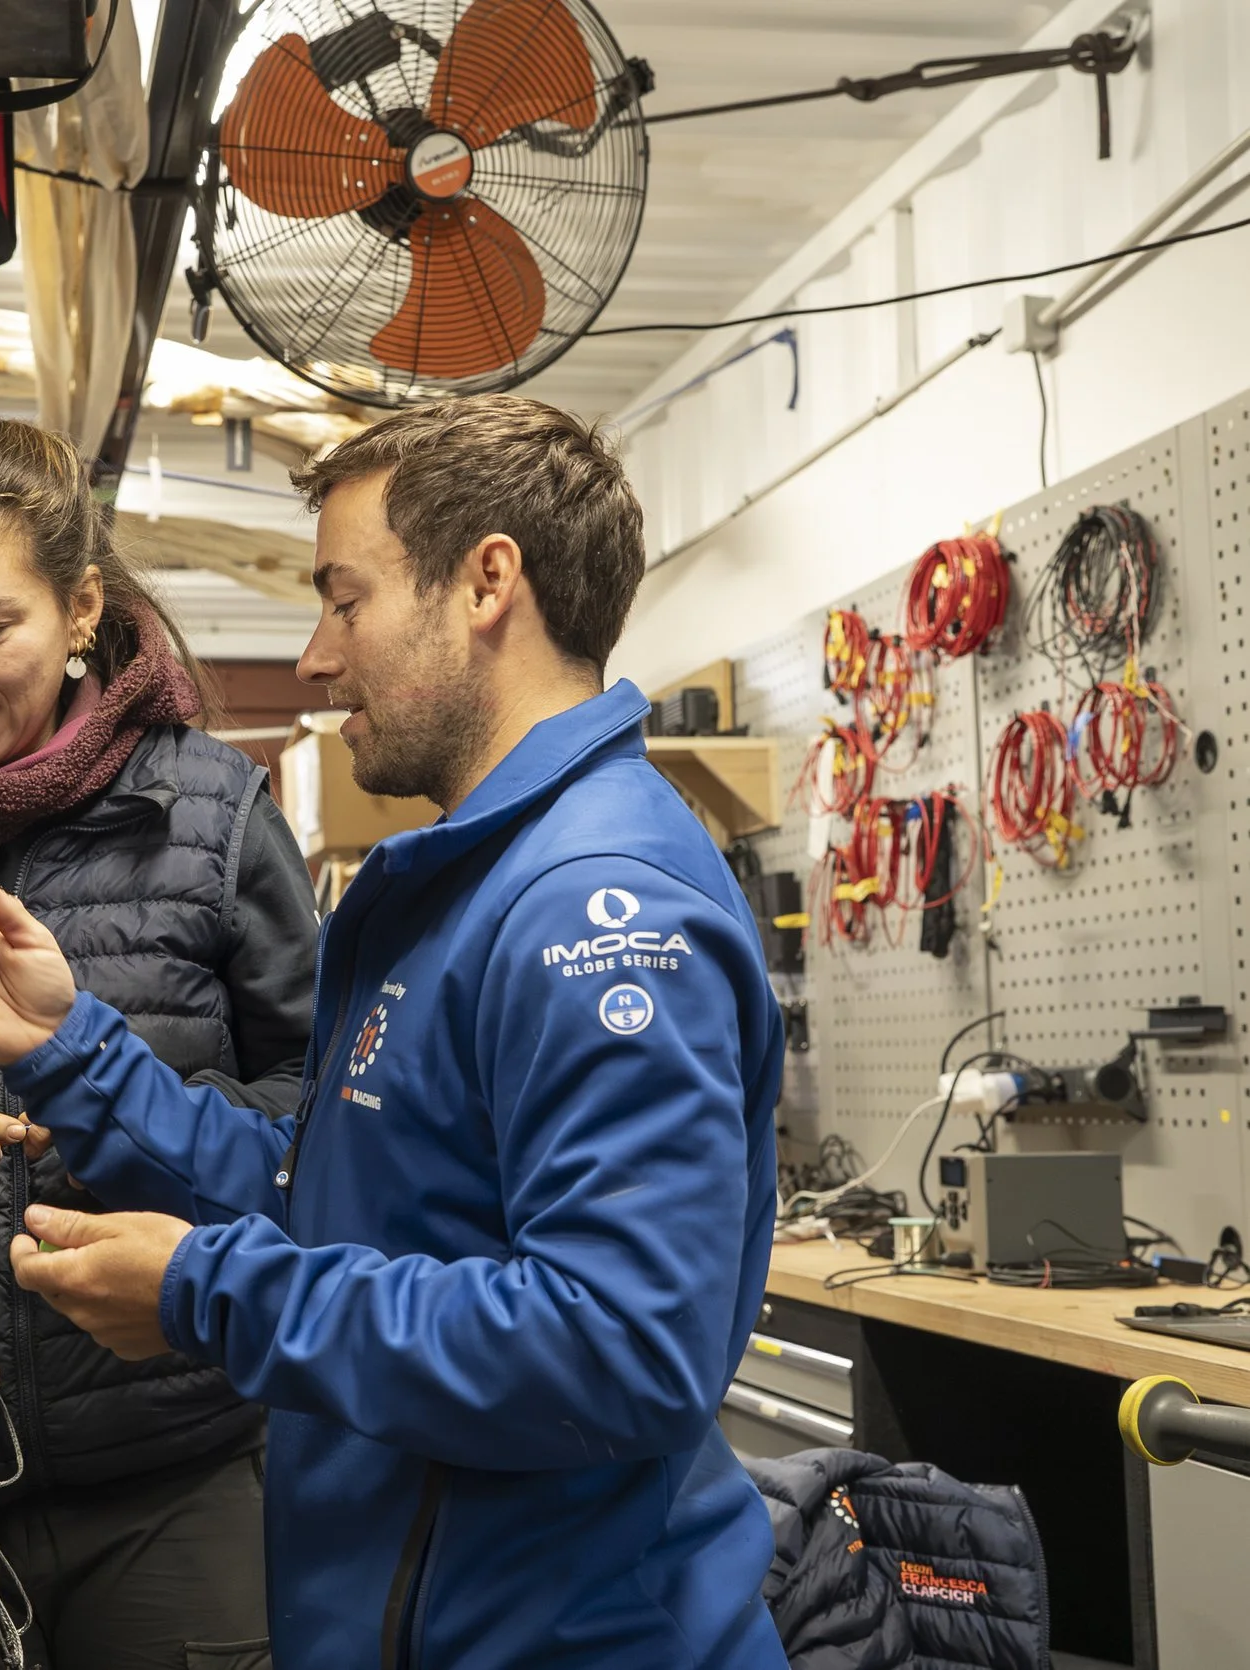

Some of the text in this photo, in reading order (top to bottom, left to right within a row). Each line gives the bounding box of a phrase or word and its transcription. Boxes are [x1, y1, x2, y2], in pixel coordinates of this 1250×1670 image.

[543, 931, 692, 966] IMOCA
[563, 954, 679, 977] GLOBE SERIES
[618, 994, 632, 1007] N
[623, 1013, 633, 1026] S
[352, 1089, 381, 1110] RACING
[900, 1561, 933, 1574] team
[901, 1572, 987, 1595] FRANCESCA
[901, 1584, 974, 1604] CLAPCICH
